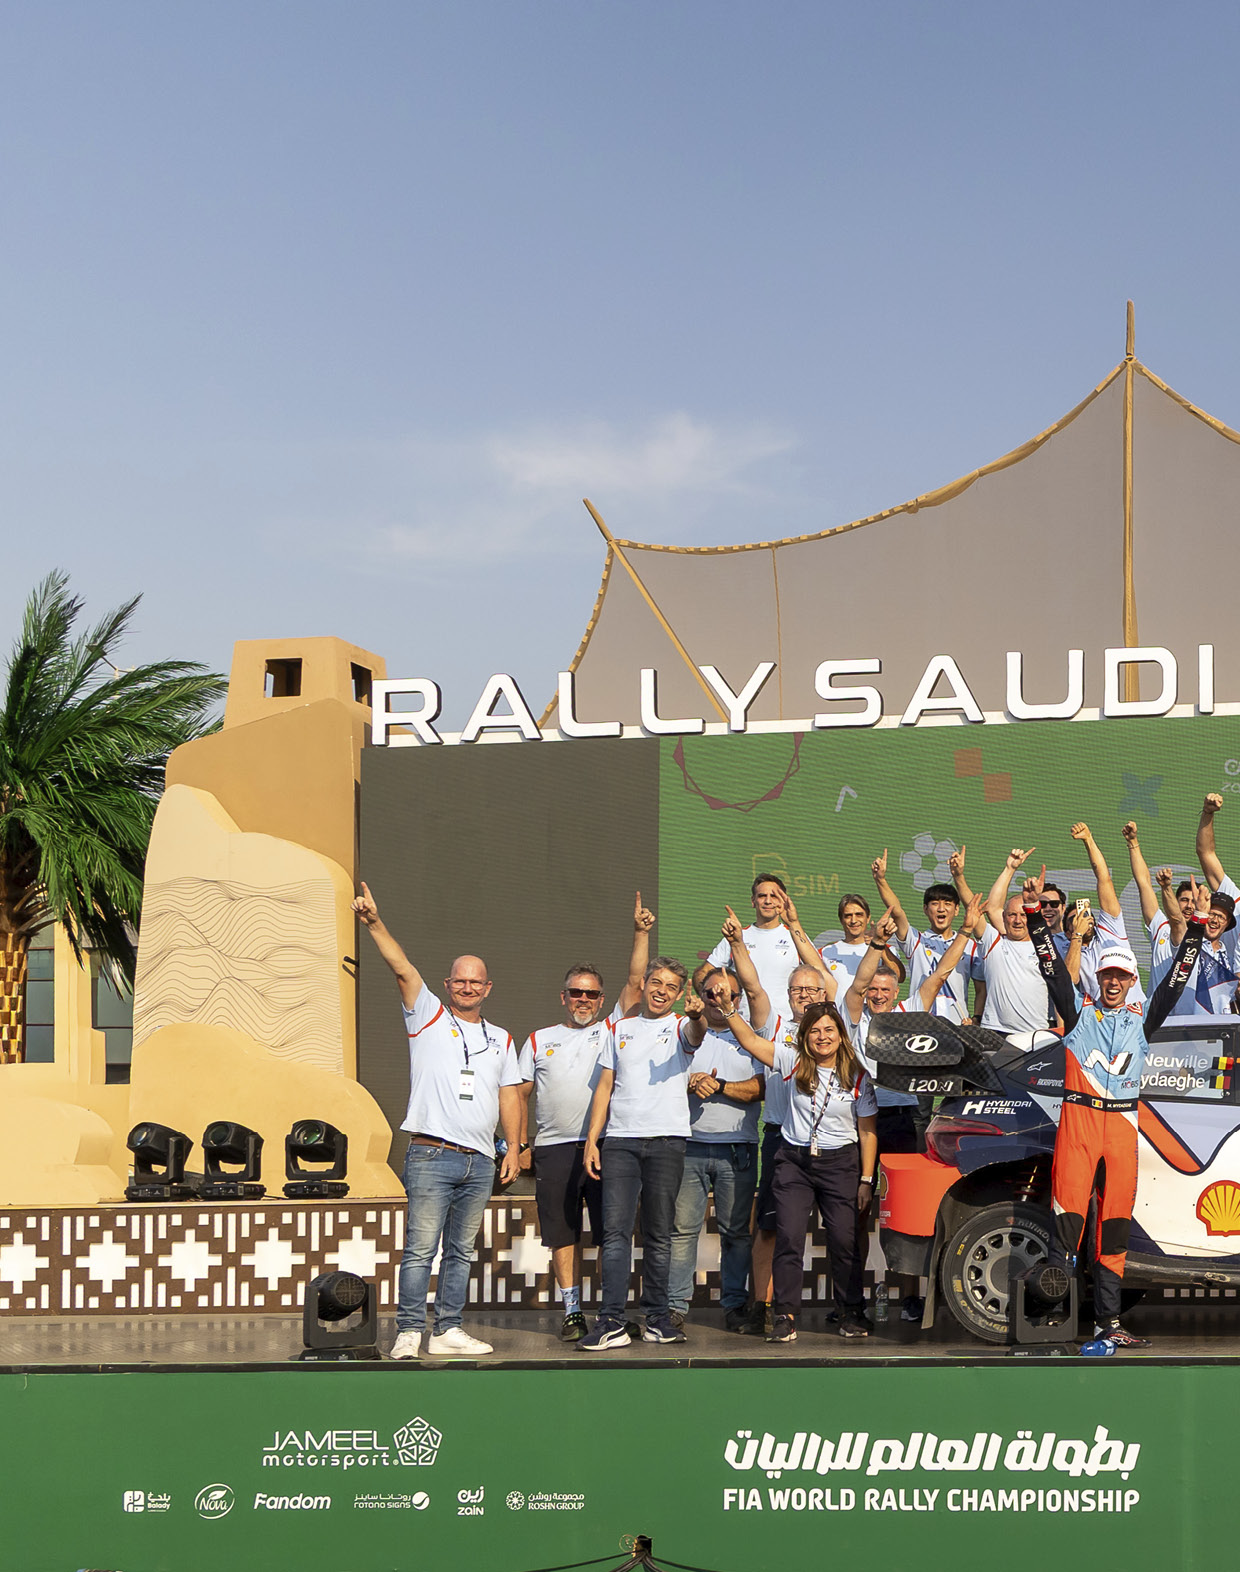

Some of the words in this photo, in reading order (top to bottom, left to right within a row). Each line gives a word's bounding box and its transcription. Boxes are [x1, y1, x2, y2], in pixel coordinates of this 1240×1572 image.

[371, 661, 777, 746] RALLY
[813, 643, 1215, 729] SAUDI
[1177, 947, 1198, 982] MOBIS
[1144, 1053, 1208, 1069] Neuville
[1140, 1072, 1205, 1091] ydaeghe
[983, 1107, 1017, 1115] STEEL
[263, 1430, 389, 1451] JAMEEL
[723, 1430, 869, 1480] للراليات
[864, 1432, 1003, 1476] العالم
[1003, 1424, 1141, 1480] بطولة
[253, 1492, 332, 1510] Fandom
[457, 1485, 485, 1504] زين
[527, 1491, 552, 1502] روشن
[552, 1492, 585, 1502] مجموعة
[723, 1488, 763, 1511] FIA
[769, 1488, 856, 1511] WORLD
[864, 1489, 940, 1511] RALLY
[946, 1489, 1140, 1512] CHAMPIONSHIP
[147, 1502, 171, 1510] Balady
[199, 1497, 229, 1512] Nova
[528, 1502, 556, 1510] ROSHN
[556, 1502, 585, 1510] GROUP
